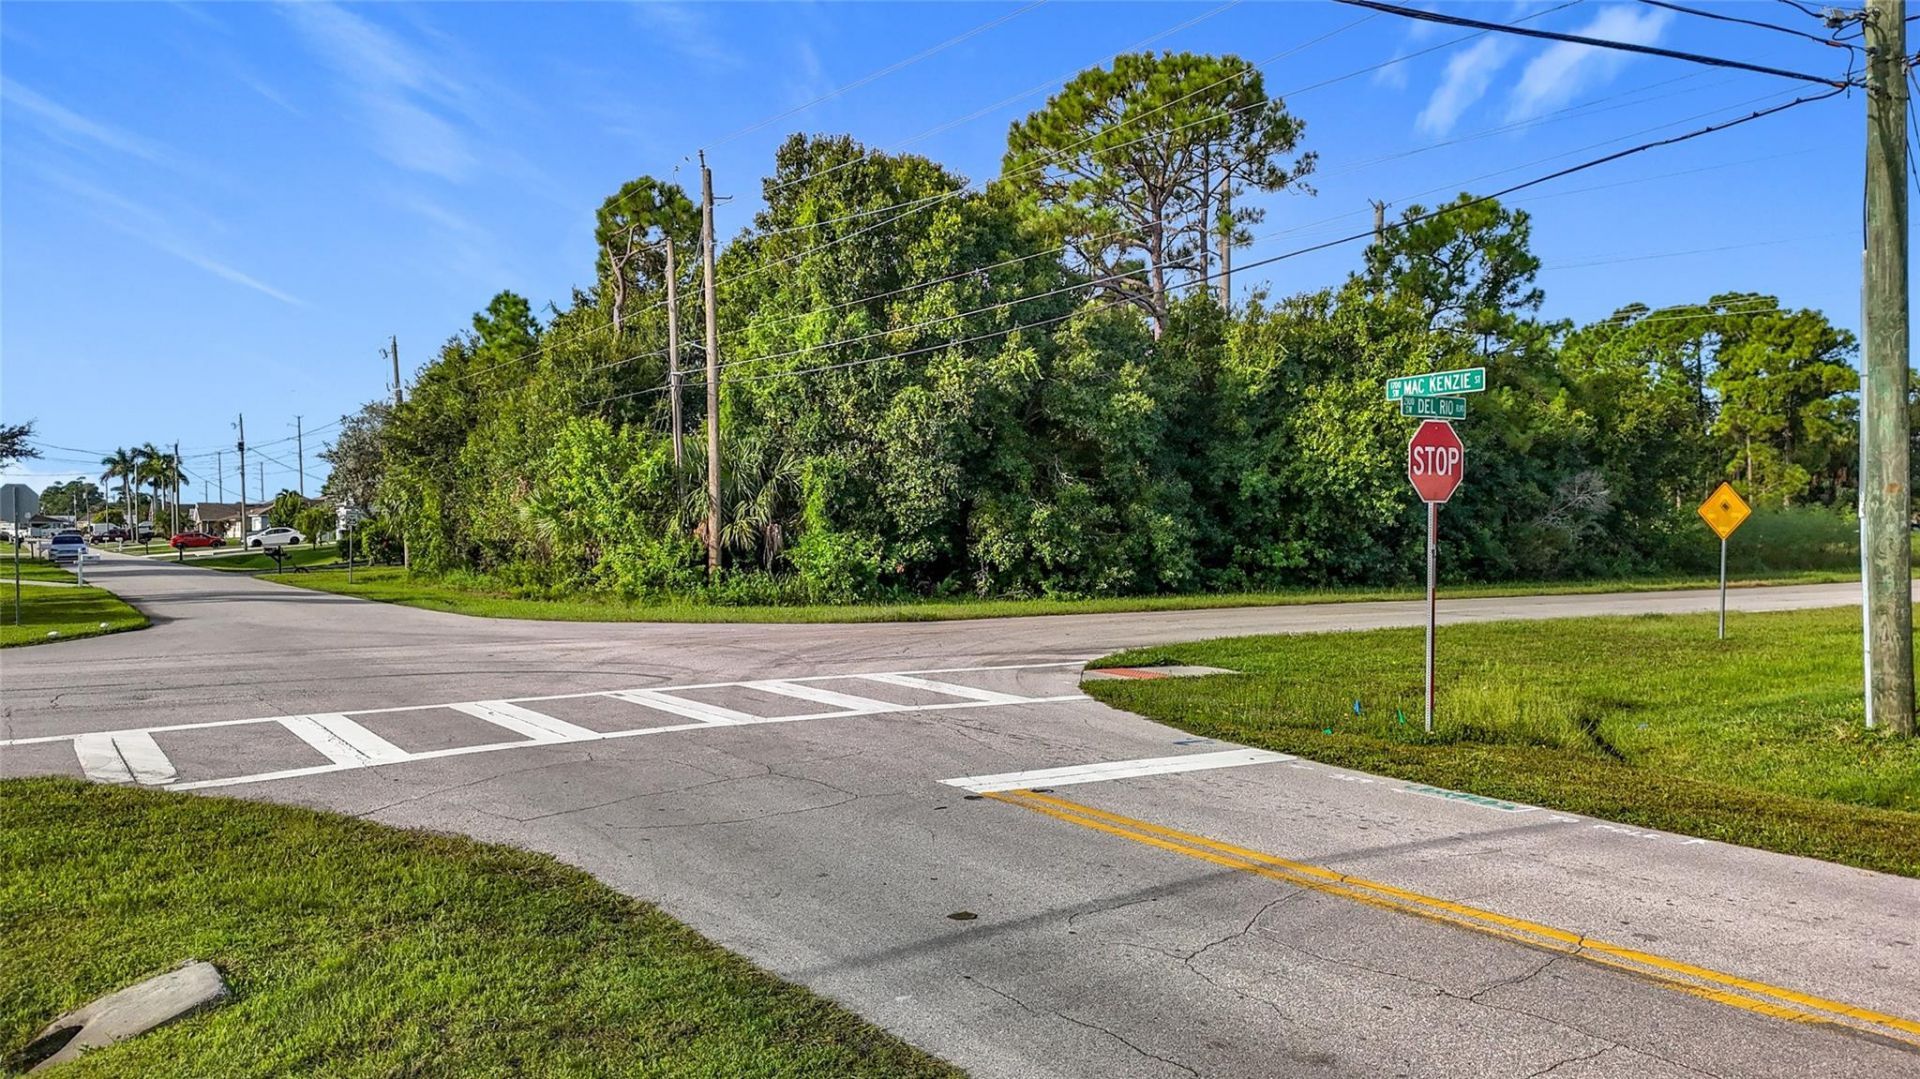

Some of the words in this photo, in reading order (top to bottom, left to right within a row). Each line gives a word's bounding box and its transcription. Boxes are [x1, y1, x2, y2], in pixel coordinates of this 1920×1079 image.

[1403, 379, 1424, 395] MAC
[1429, 373, 1471, 392] KENZIE
[1474, 375, 1481, 384] ST
[1417, 398, 1436, 414] DEL
[1439, 400, 1454, 415] RIO
[1413, 445, 1459, 476] STOP
